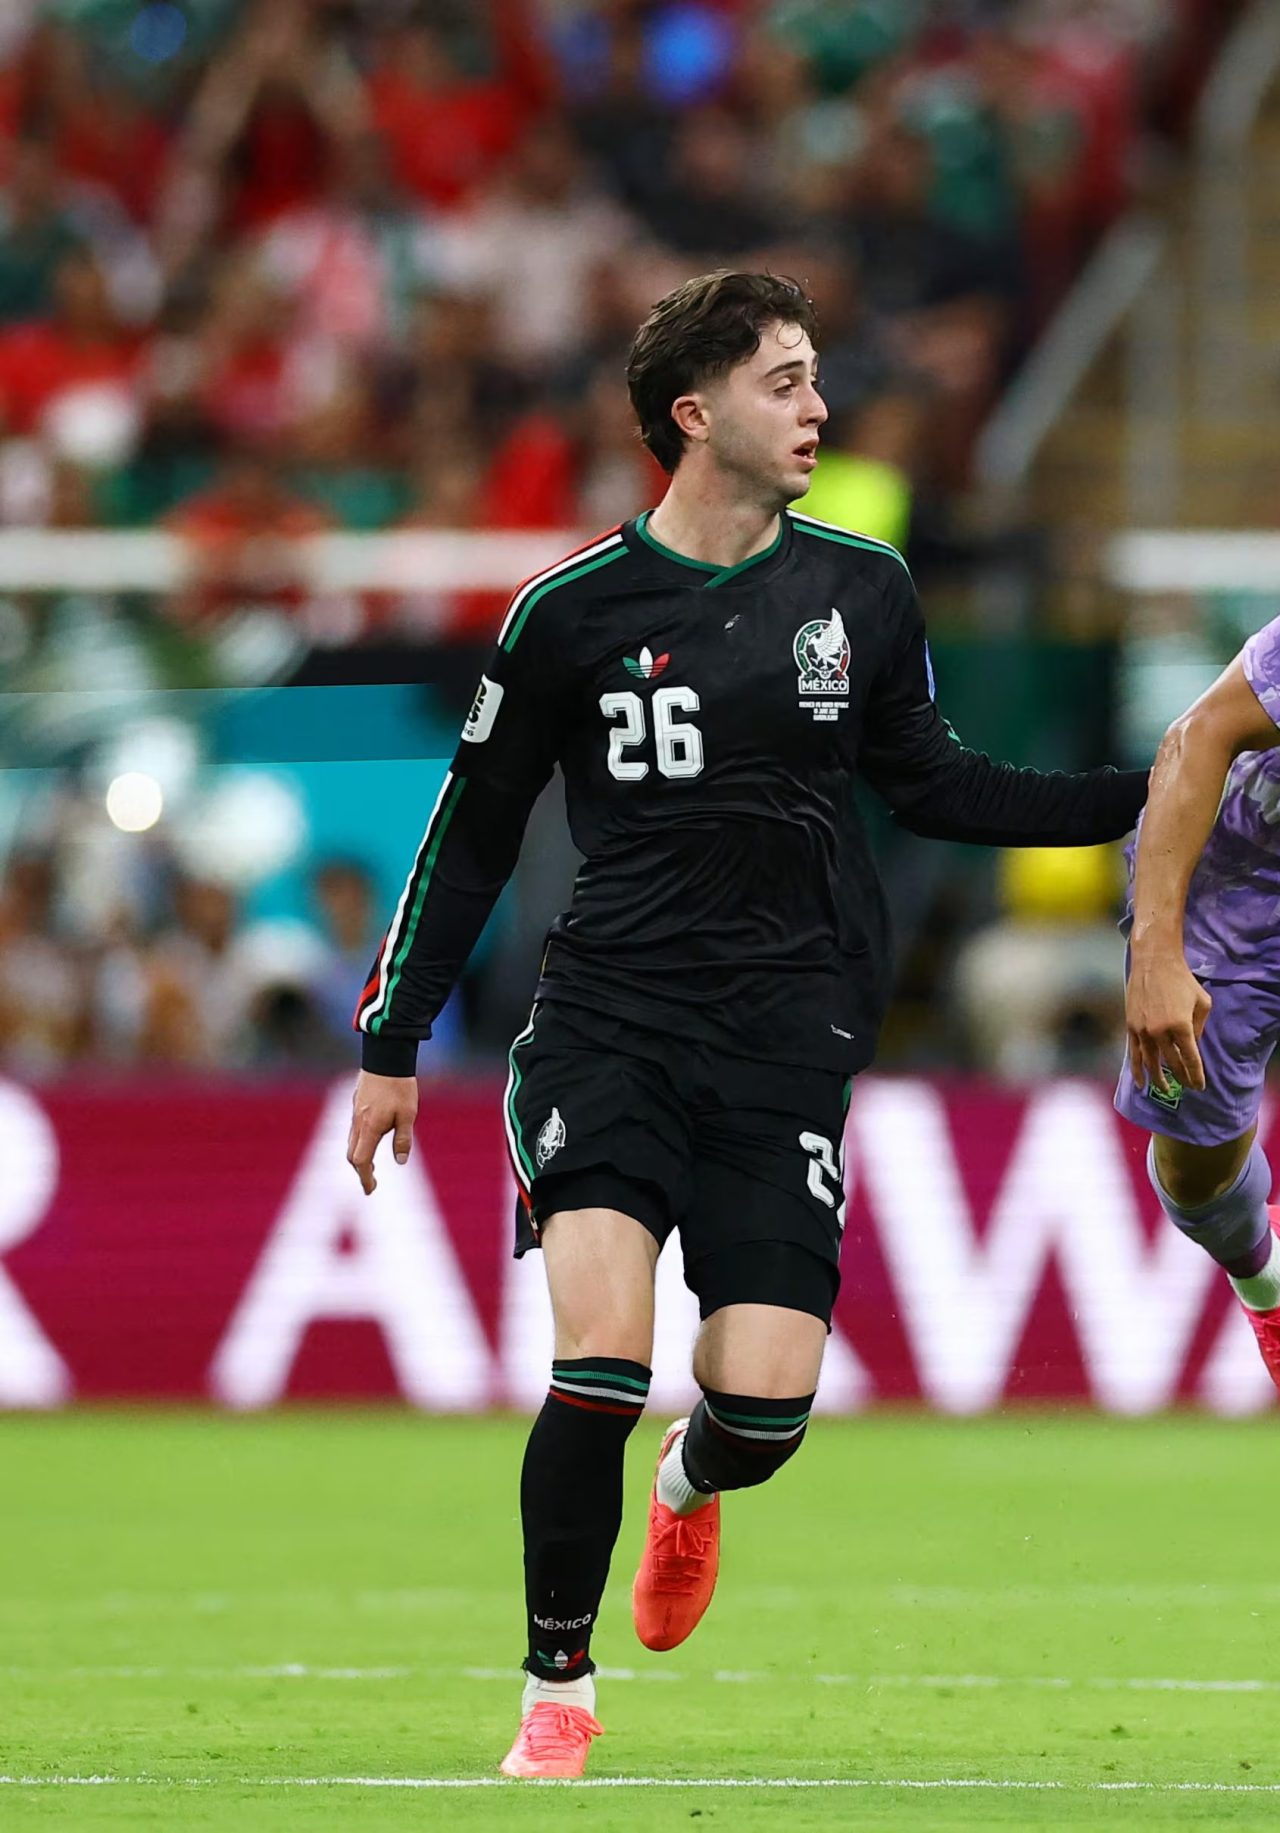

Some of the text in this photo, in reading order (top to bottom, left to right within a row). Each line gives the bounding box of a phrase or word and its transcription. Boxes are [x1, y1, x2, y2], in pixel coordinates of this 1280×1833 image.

[802, 677, 847, 691] MÉXICO
[599, 685, 705, 781] 26
[799, 1131, 847, 1231] 2
[533, 1612, 592, 1631] MÉXICO
